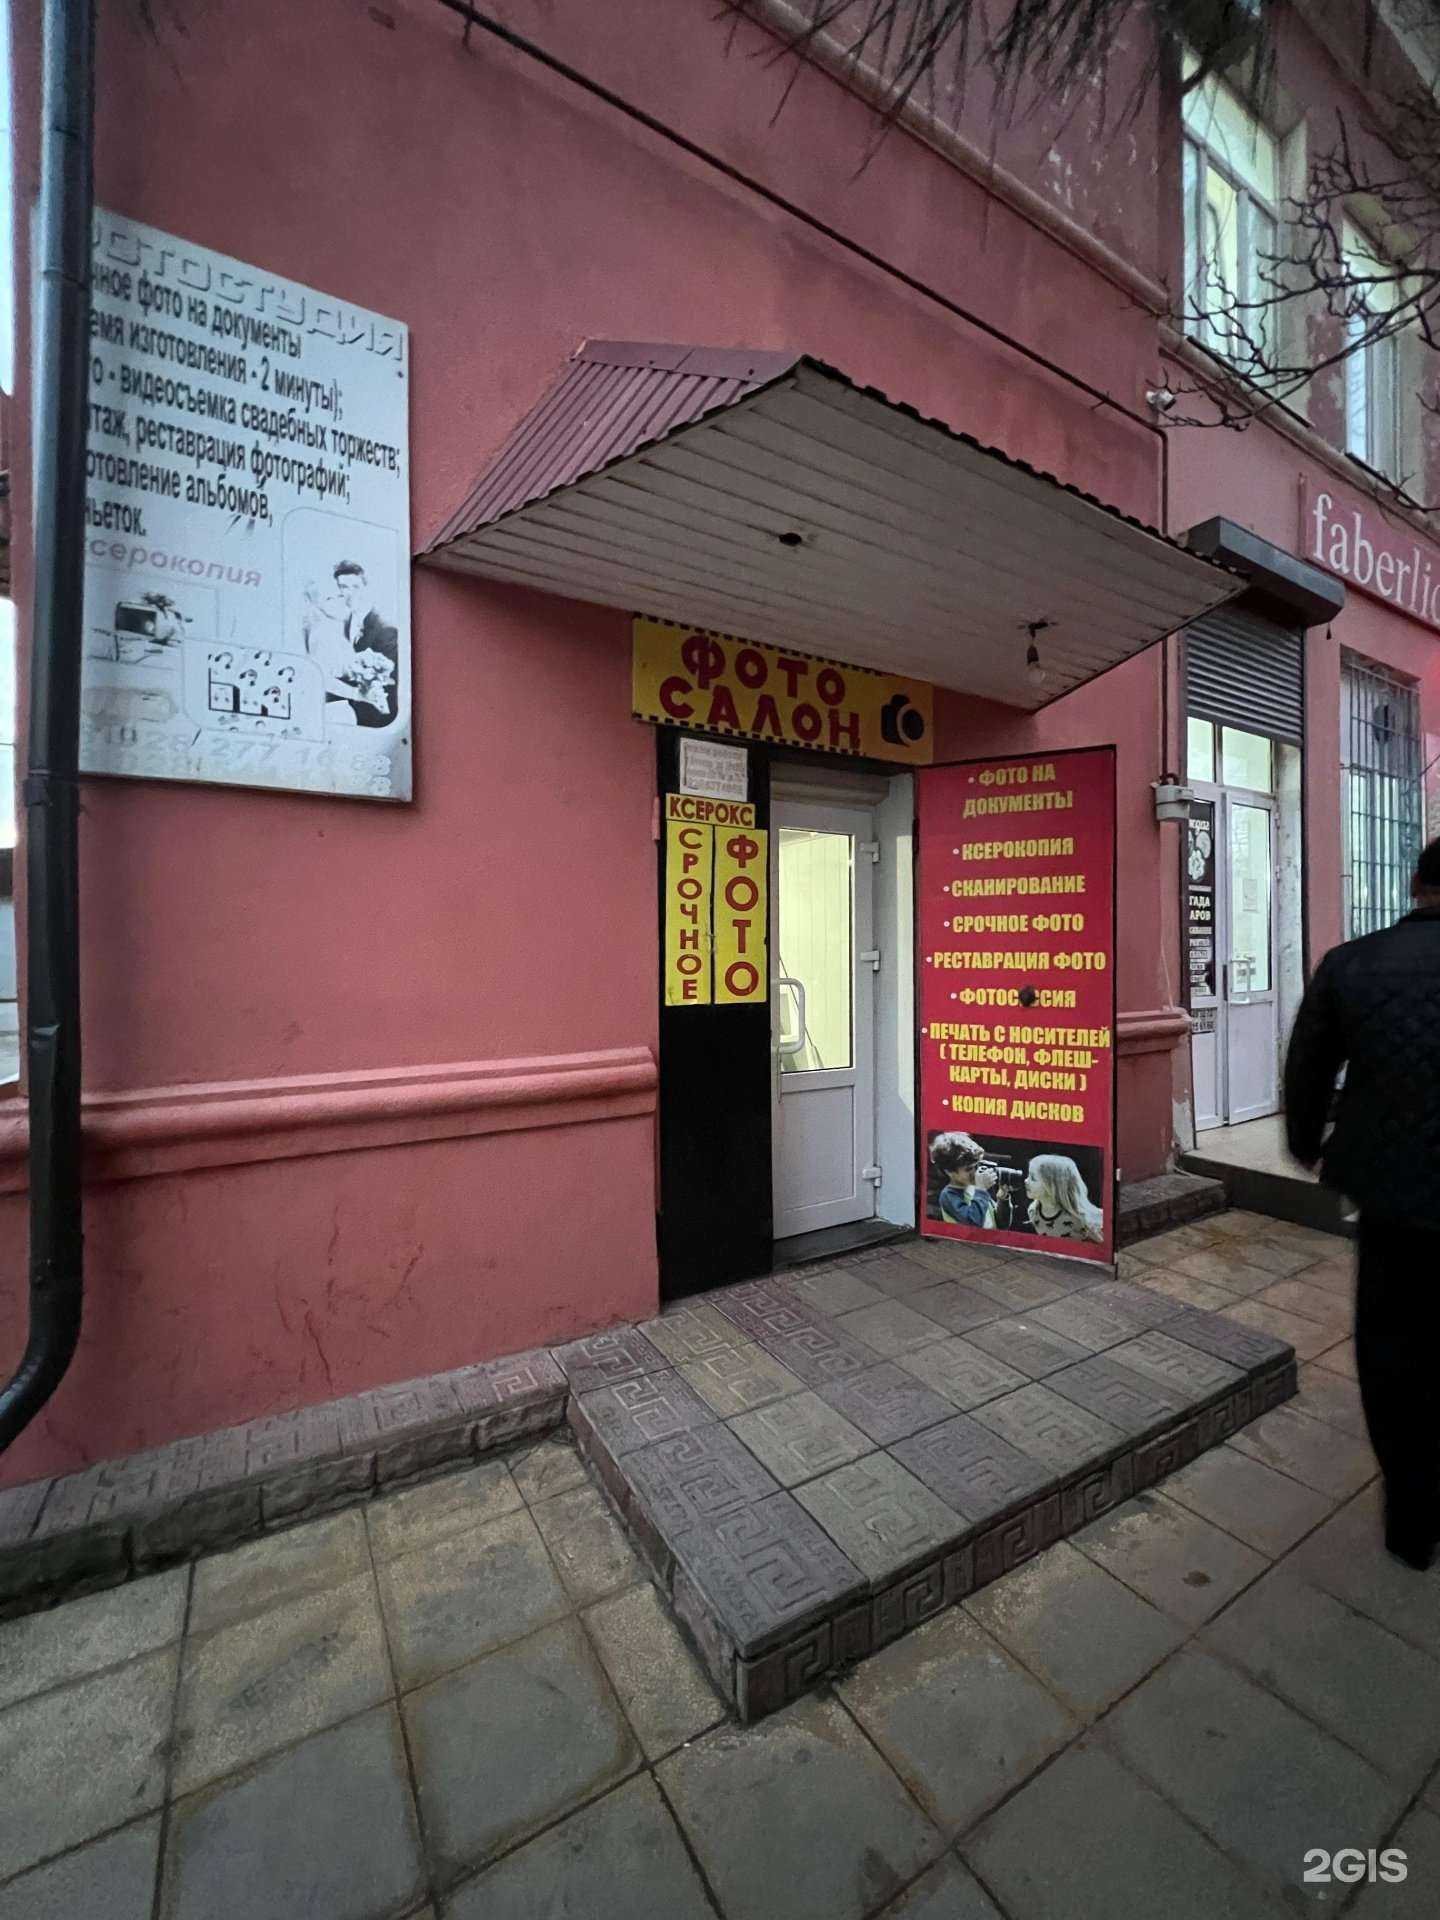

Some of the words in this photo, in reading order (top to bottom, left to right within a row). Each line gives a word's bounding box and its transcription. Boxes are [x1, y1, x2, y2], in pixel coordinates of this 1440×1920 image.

[138, 269, 183, 319] фото
[188, 296, 208, 327] на
[212, 305, 302, 359] документы
[130, 321, 247, 384] изготовления
[261, 355, 270, 391] 2
[121, 364, 236, 425] видеосъемка
[241, 402, 327, 452] свадебных
[331, 428, 400, 478] торжеств;
[136, 415, 245, 473] реставрация
[187, 473, 272, 527] альбомов,
[681, 632, 846, 706] ФОТО
[659, 676, 861, 750] САЛОН
[979, 766, 1027, 786] ФОТО
[1032, 764, 1056, 782] НА
[669, 799, 753, 827] КСЕРОКС
[962, 791, 1073, 818] ДОКУМЕНТЫ
[962, 837, 1074, 860] КСЕРОКОПИЯ
[952, 875, 1086, 897] СКАНИРОВАНИЕ
[677, 828, 703, 1000] СРОЧНОЕ
[725, 833, 759, 997] ФОТО
[953, 915, 1029, 933] СРОЧНОЕ
[1032, 913, 1084, 932] ФОТО
[933, 952, 1049, 972] РЕСТАВРАЦИЯ
[1053, 952, 1106, 970] ФОТО
[959, 988, 1076, 1008] ФОТОССИЯ
[930, 1023, 990, 1041] ПЕЧАТЬ
[994, 1026, 1005, 1043] С
[1009, 1026, 1111, 1048] НОСИТЕЛЕЙ
[1033, 1048, 1099, 1068] ФЛЕШ-
[949, 1066, 1011, 1087] КАРТЫ,
[952, 1095, 1007, 1115] КОПИЯ
[1010, 1100, 1084, 1123] ДИСКОВ
